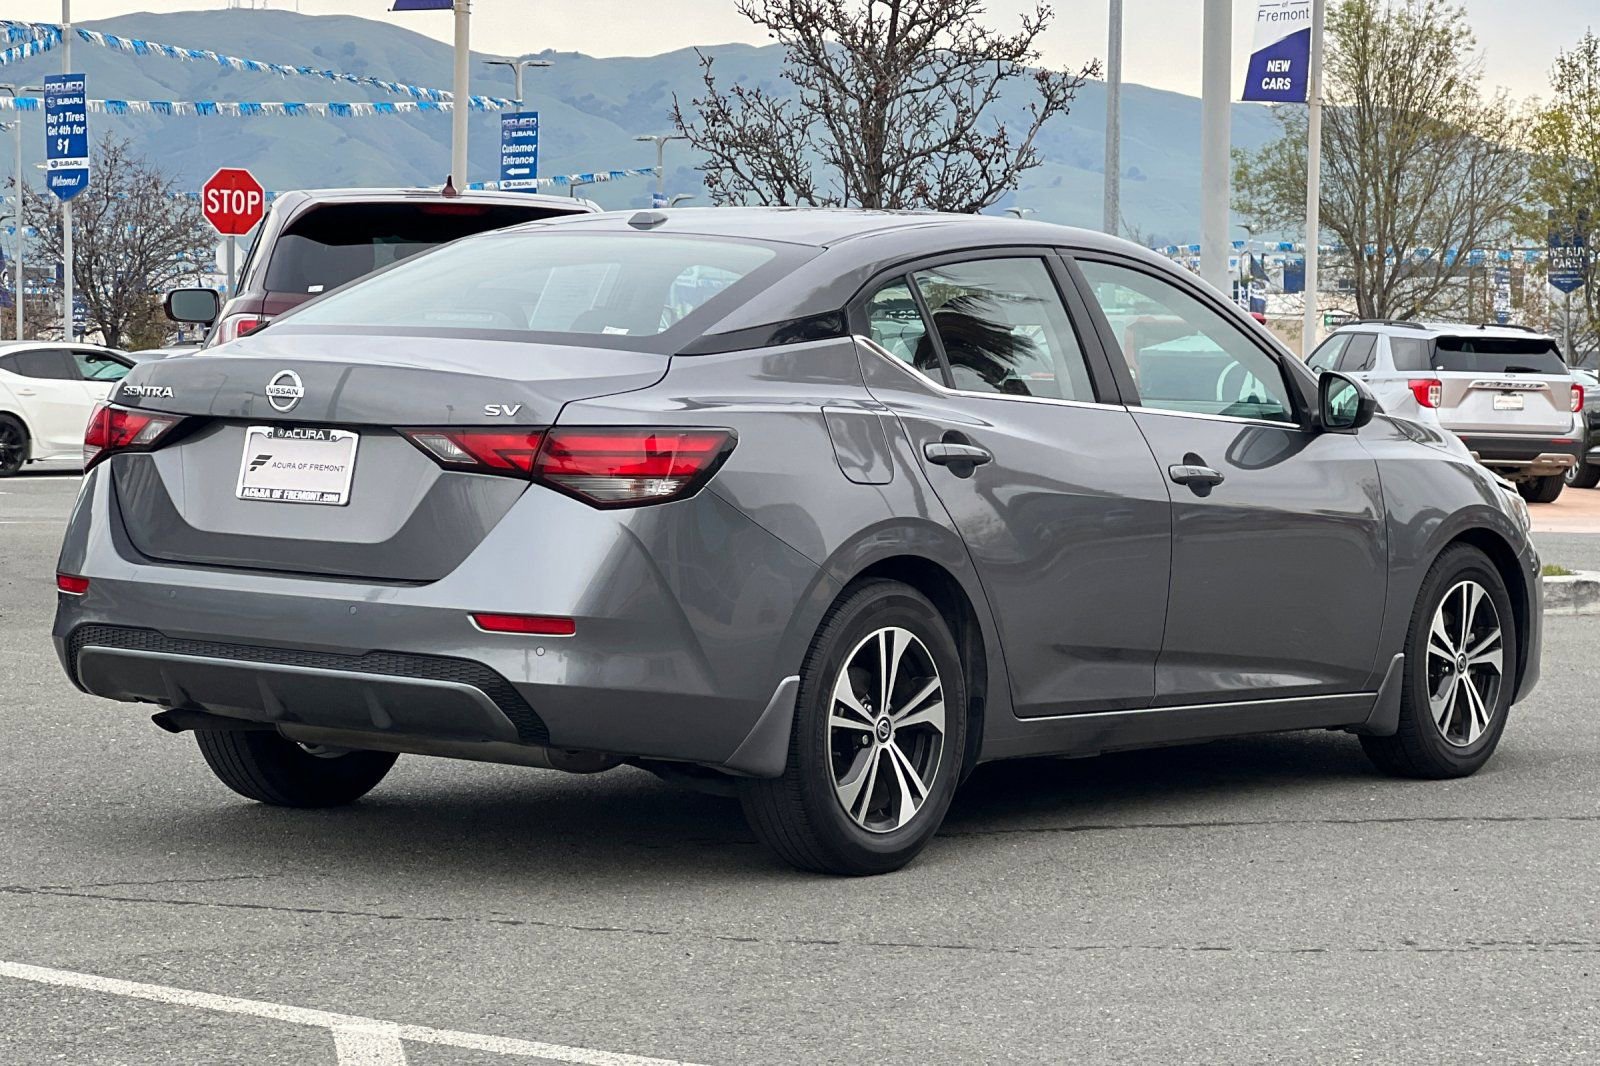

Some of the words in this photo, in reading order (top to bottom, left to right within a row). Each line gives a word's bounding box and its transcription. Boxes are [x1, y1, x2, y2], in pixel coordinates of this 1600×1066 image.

[1257, 8, 1309, 21] Fremont
[1266, 60, 1291, 73] NEW
[1261, 77, 1292, 90] CARS
[56, 97, 83, 105] SUBARU
[47, 113, 58, 124] Buy
[59, 112, 64, 122] 3
[65, 111, 85, 122] Tires
[47, 125, 58, 136] Get
[59, 125, 71, 135] 4th
[72, 124, 86, 135] for
[57, 138, 70, 154] $1
[502, 144, 536, 153] Customer
[502, 155, 535, 165] Entrance
[51, 174, 81, 187] Welcome!
[206, 188, 261, 215] STOP
[123, 385, 174, 398] SENTRA
[266, 386, 300, 396] NISSAN
[484, 404, 522, 417] SV
[284, 429, 325, 440] ACURA
[271, 461, 297, 470] ACURA
[308, 463, 346, 473] FREMONT
[242, 487, 272, 499] ACURA
